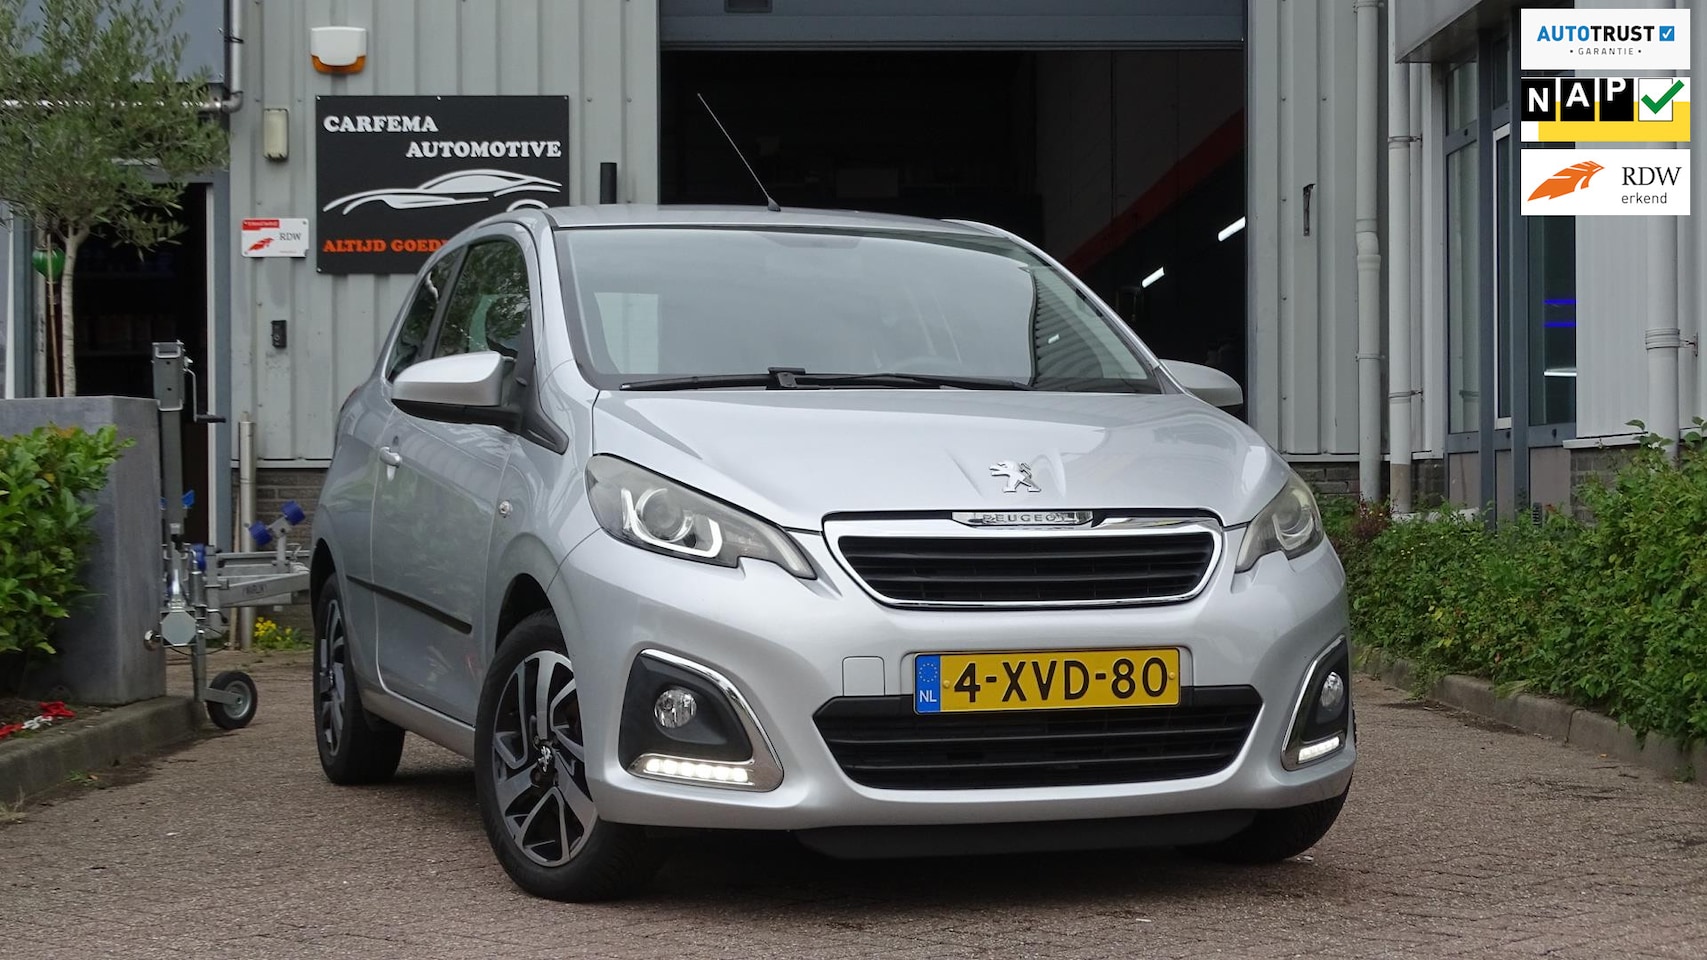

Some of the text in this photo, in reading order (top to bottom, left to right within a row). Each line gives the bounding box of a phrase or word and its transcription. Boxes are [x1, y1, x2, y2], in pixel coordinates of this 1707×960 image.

[323, 115, 438, 133] CARFEMA
[406, 141, 562, 158] AUTOMOTIVE
[279, 232, 302, 241] RDW
[323, 239, 448, 253] ALTIJD GOED
[953, 657, 1168, 703] 4-XVD-80
[919, 690, 937, 703] NL
